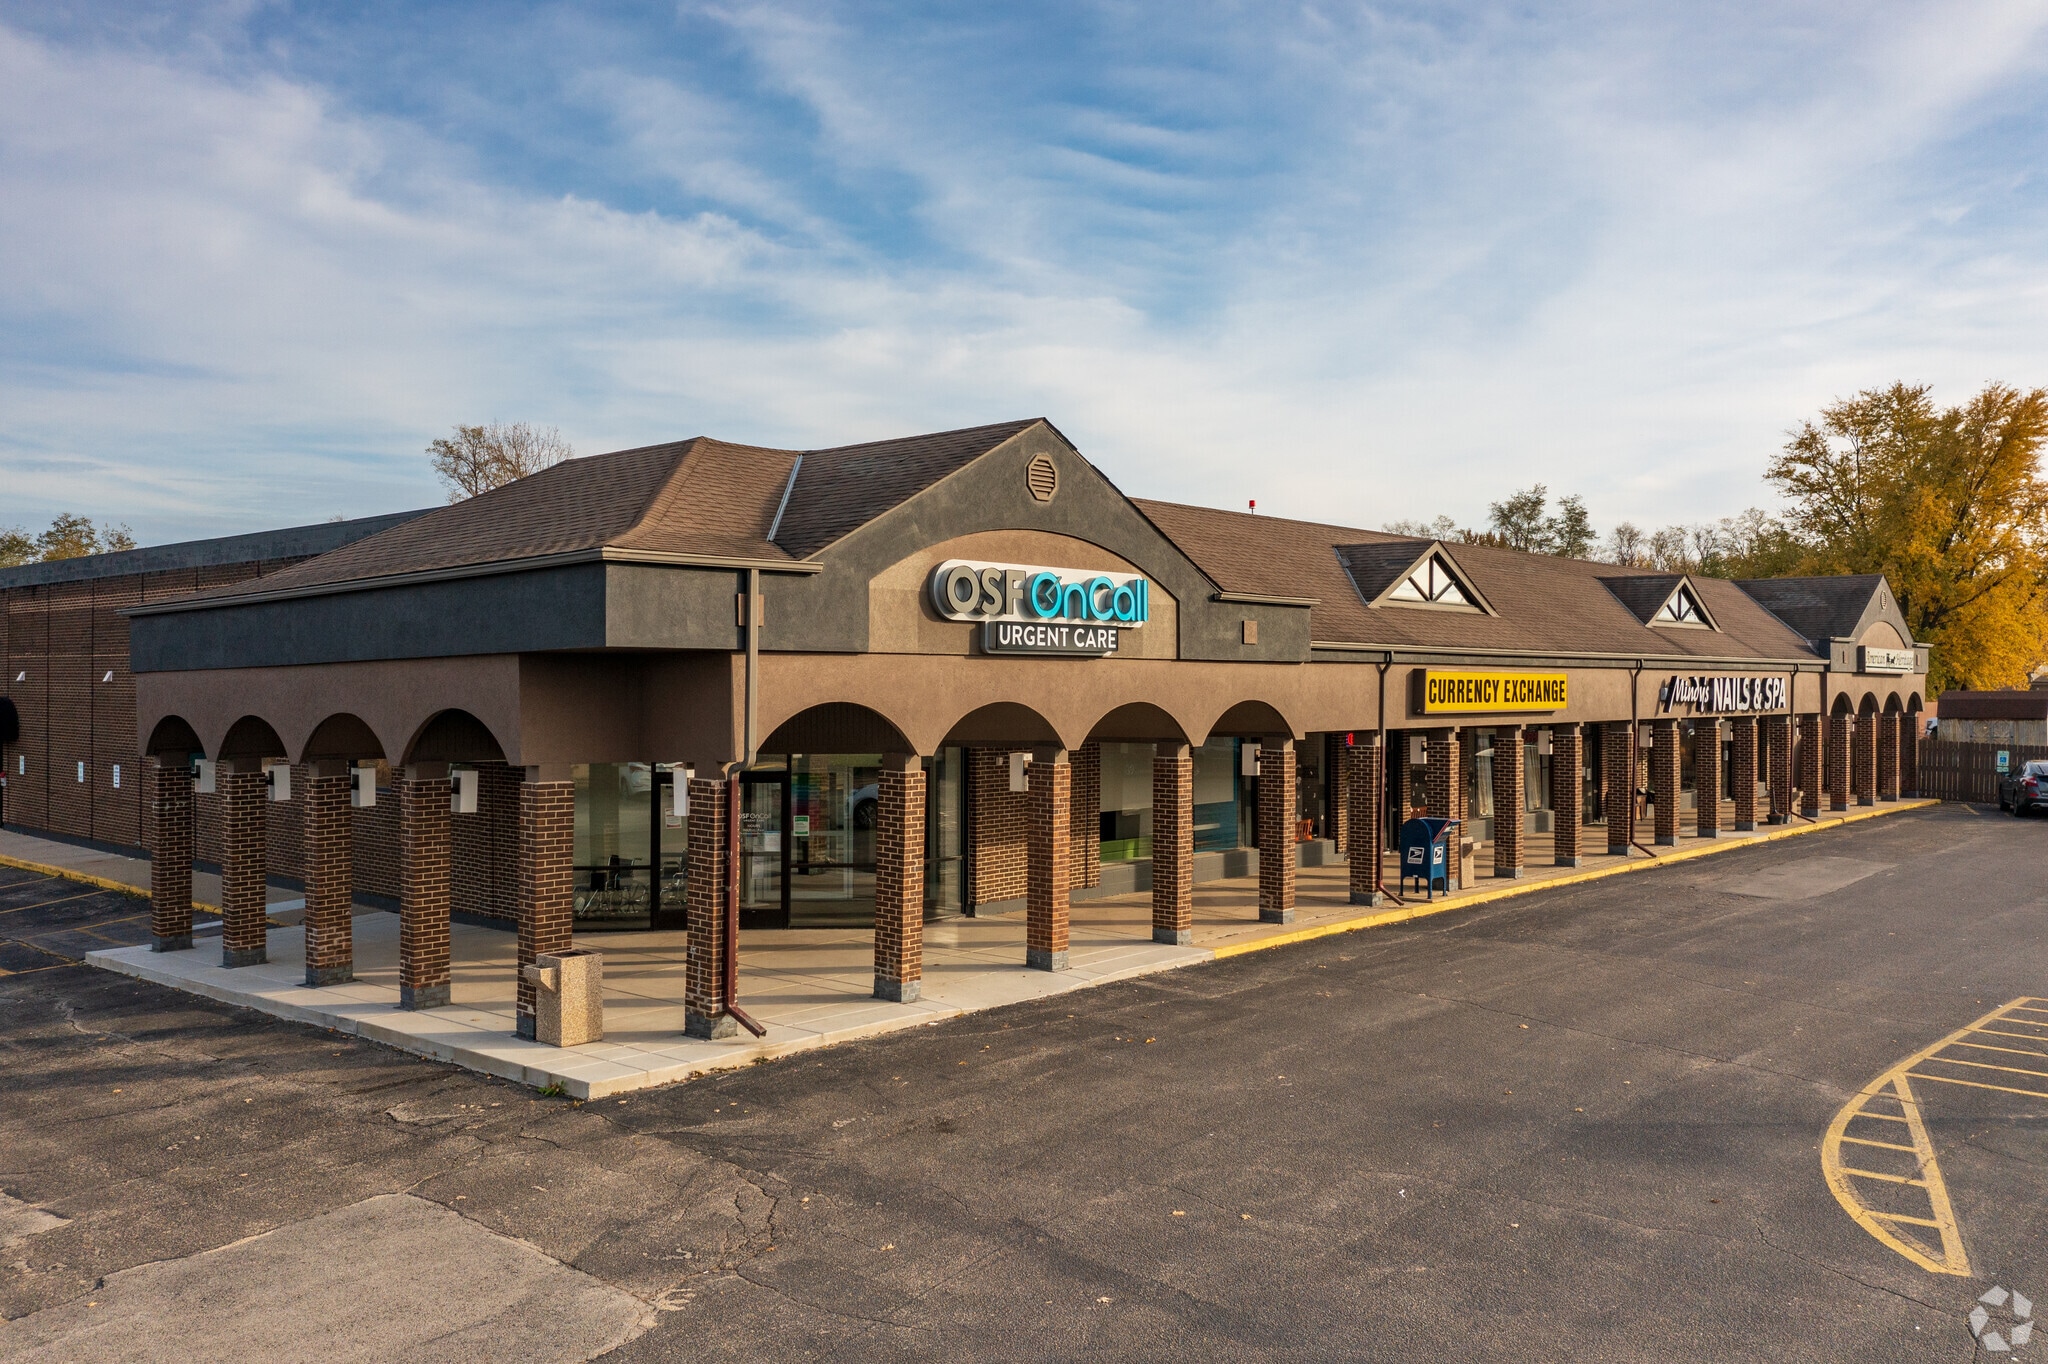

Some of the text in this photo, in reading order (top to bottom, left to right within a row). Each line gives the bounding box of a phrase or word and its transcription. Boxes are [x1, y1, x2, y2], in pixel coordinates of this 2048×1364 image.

[945, 565, 1149, 622] OSF OnCall
[999, 625, 1117, 649] URGENT CARE
[1428, 678, 1565, 704] CURRENCY EXCHANGE
[1668, 676, 1787, 713] Mindy's NAILS & SPA
